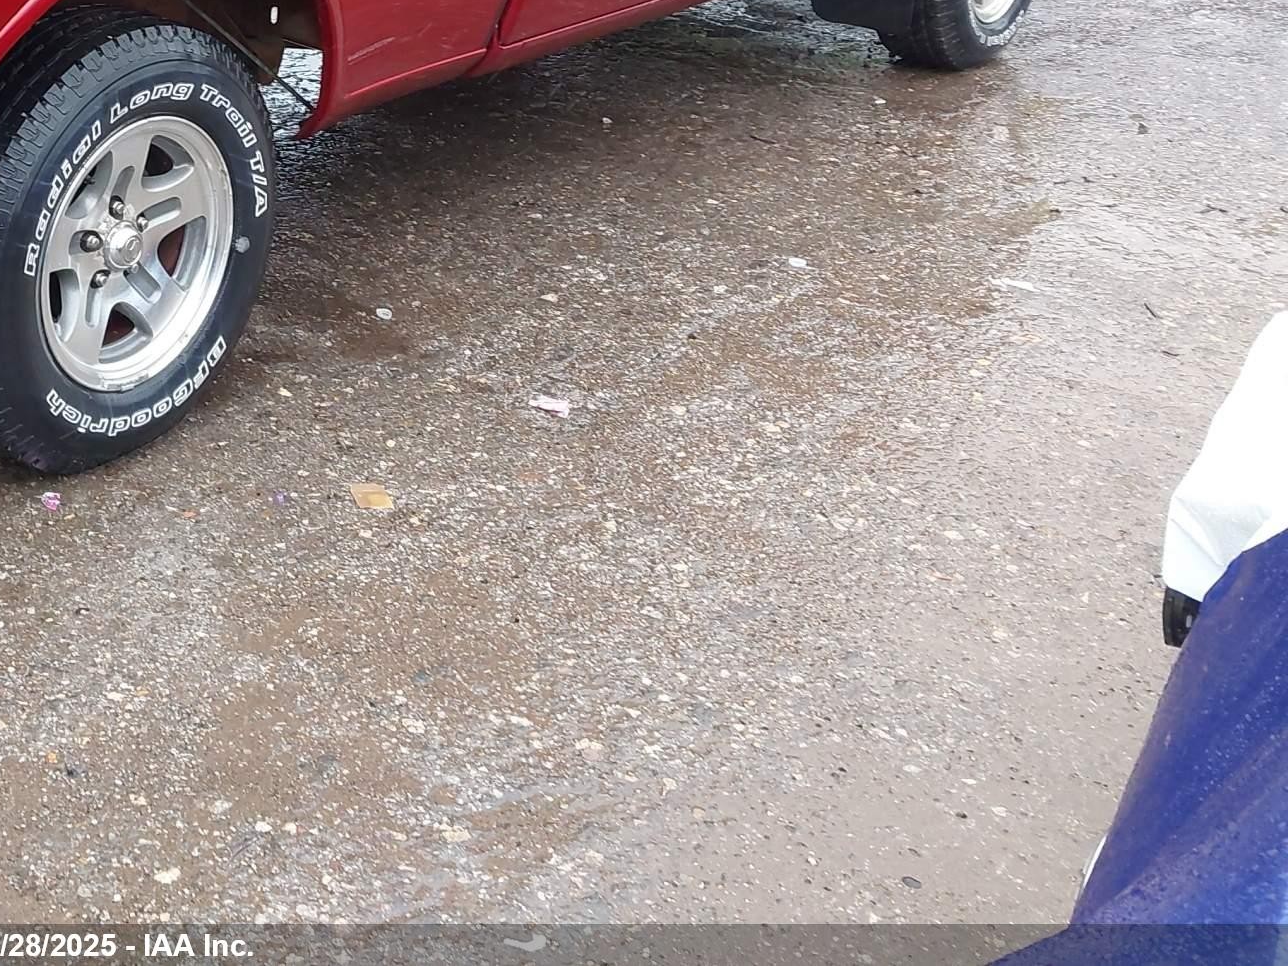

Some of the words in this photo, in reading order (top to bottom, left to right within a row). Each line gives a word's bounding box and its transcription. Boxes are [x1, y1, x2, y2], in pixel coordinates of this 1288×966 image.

[24, 122, 102, 276] Radial
[109, 81, 194, 129] Long
[200, 83, 258, 147] Trail
[249, 151, 269, 218] T/A
[45, 335, 227, 437] BFGoodrich
